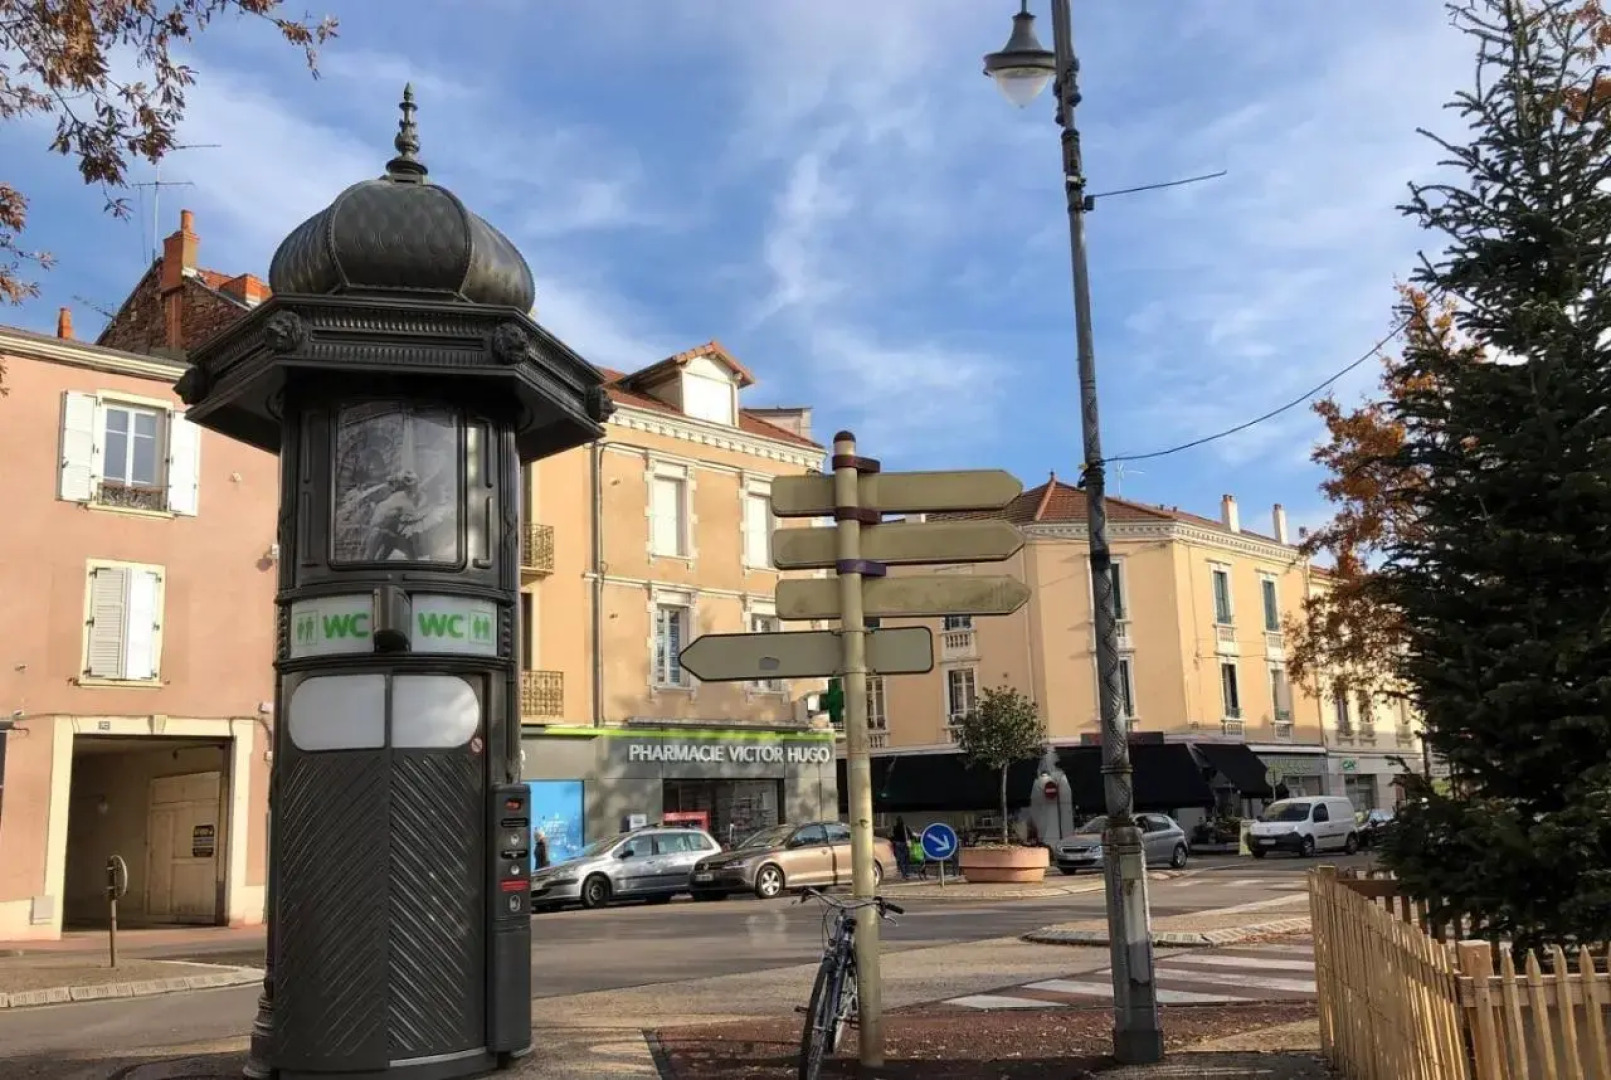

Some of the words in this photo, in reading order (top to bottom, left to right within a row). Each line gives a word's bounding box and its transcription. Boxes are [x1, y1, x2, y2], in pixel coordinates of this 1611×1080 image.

[323, 613, 370, 639] WC
[418, 612, 464, 638] WC
[628, 744, 725, 762] PHARMACIE
[729, 745, 784, 763] VICTOR
[787, 747, 831, 764] HUGO
